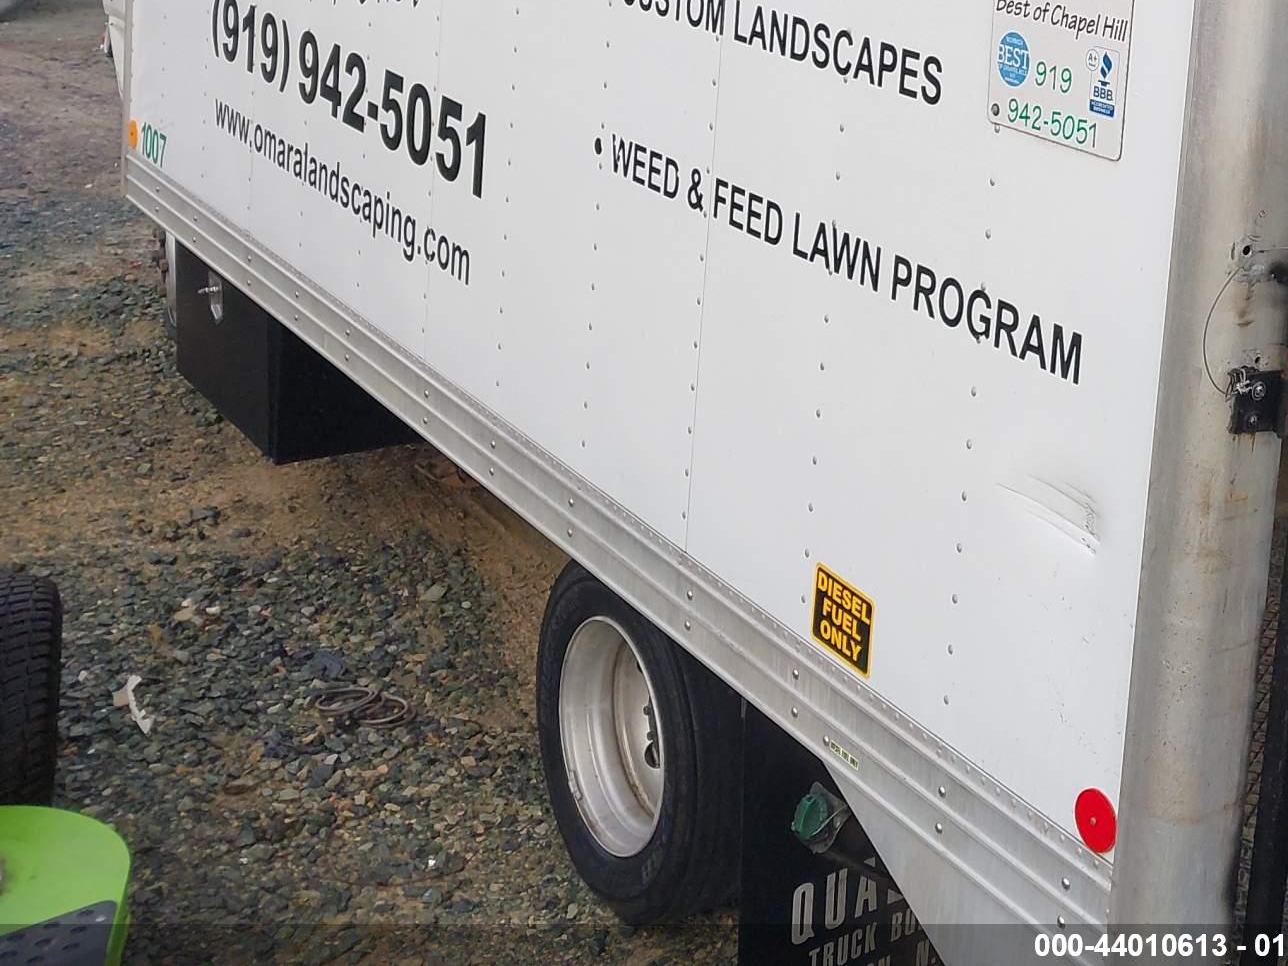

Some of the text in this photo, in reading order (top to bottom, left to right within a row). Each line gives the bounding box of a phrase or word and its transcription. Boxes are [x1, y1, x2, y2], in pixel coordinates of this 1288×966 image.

[1033, 2, 1051, 24] of
[1050, 4, 1101, 40] Chapel
[1103, 15, 1128, 42] Hill
[734, 0, 944, 107] LANDSCAPES
[998, 43, 1030, 70] BEST
[1034, 61, 1073, 94] 919
[1093, 85, 1113, 102] BBB
[298, 30, 486, 198] 942-5051
[1007, 98, 1098, 148] 942-5051
[141, 121, 167, 168] 1007
[215, 98, 471, 285] www.omaralandscaping.com
[611, 134, 1083, 385] WEED & FEED LAWN PROGRAM
[817, 571, 871, 626] DIESEL
[822, 596, 862, 642] FUEL
[820, 619, 862, 662] ONLY
[808, 921, 878, 966] TRUCK
